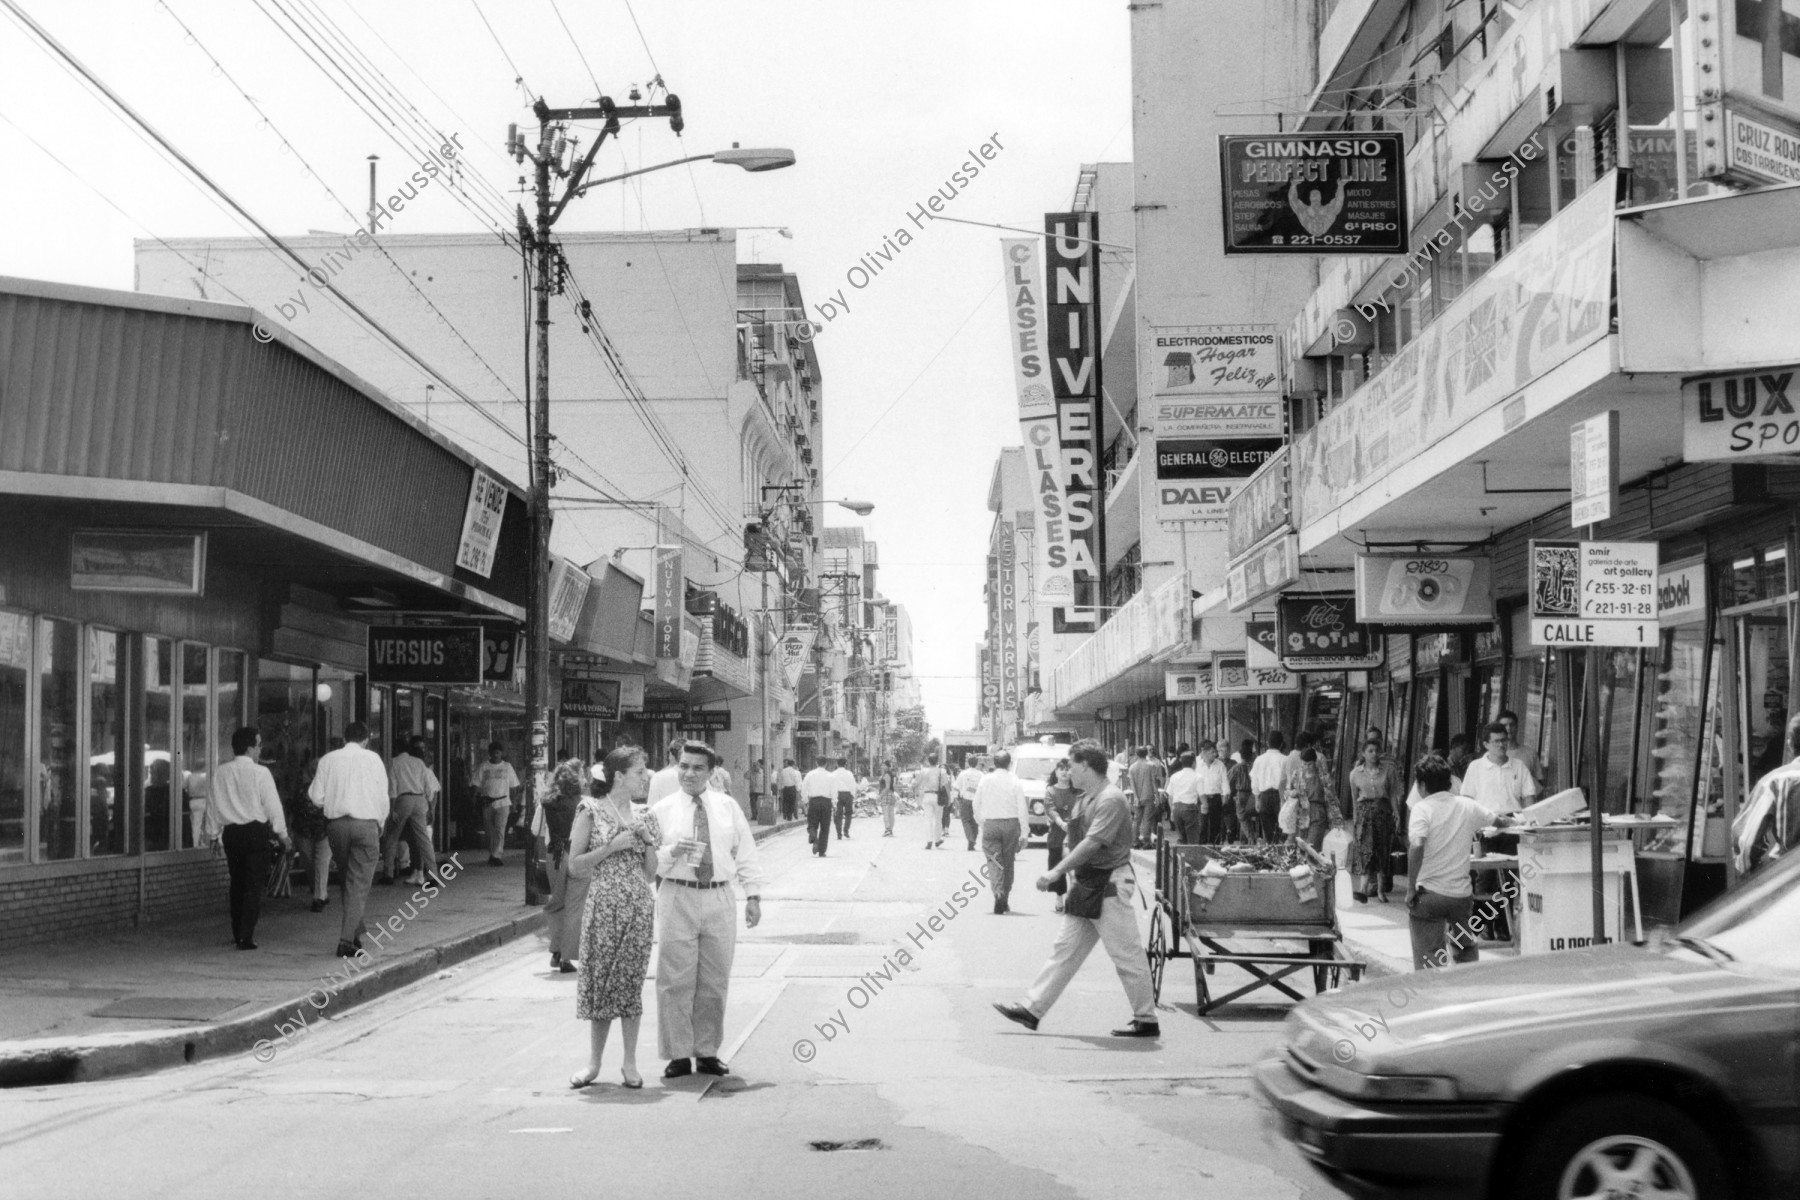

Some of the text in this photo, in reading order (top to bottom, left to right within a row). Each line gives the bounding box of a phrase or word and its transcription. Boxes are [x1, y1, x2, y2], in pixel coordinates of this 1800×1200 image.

[1738, 122, 1771, 153] CRUZ
[1246, 140, 1381, 157] GIMNASIO
[1241, 158, 1387, 182] PERFECT LINE
[1233, 190, 1260, 198] PESAS
[1347, 189, 1371, 197] MIXTO
[1347, 201, 1397, 209] ANTIESTRES
[1348, 212, 1386, 220] MASAJES
[1361, 223, 1397, 231] PISO
[1290, 235, 1361, 245] 221-0537
[1009, 244, 1042, 378] CLASES
[1157, 335, 1274, 347] ELECTRODOMESTICOS
[1197, 346, 1257, 365] Hogar
[1210, 366, 1258, 386] Feliz
[1698, 372, 1796, 423] LUX
[1158, 405, 1276, 418] SUPERMATIC
[1055, 221, 1098, 623] UNIVERSAL
[1160, 453, 1208, 466] GENERAL
[1029, 424, 1068, 568] CLASES
[1588, 547, 1611, 556] amir
[1604, 567, 1653, 578] art gallery
[664, 561, 674, 608] NUEVA
[1595, 582, 1652, 595] 255-32-61
[1595, 602, 1652, 614] 221-91-28
[663, 615, 673, 652] YORK
[1543, 624, 1644, 642] CALLE 1
[374, 639, 445, 665] VERSUS
[1004, 623, 1016, 708] VARGAS
